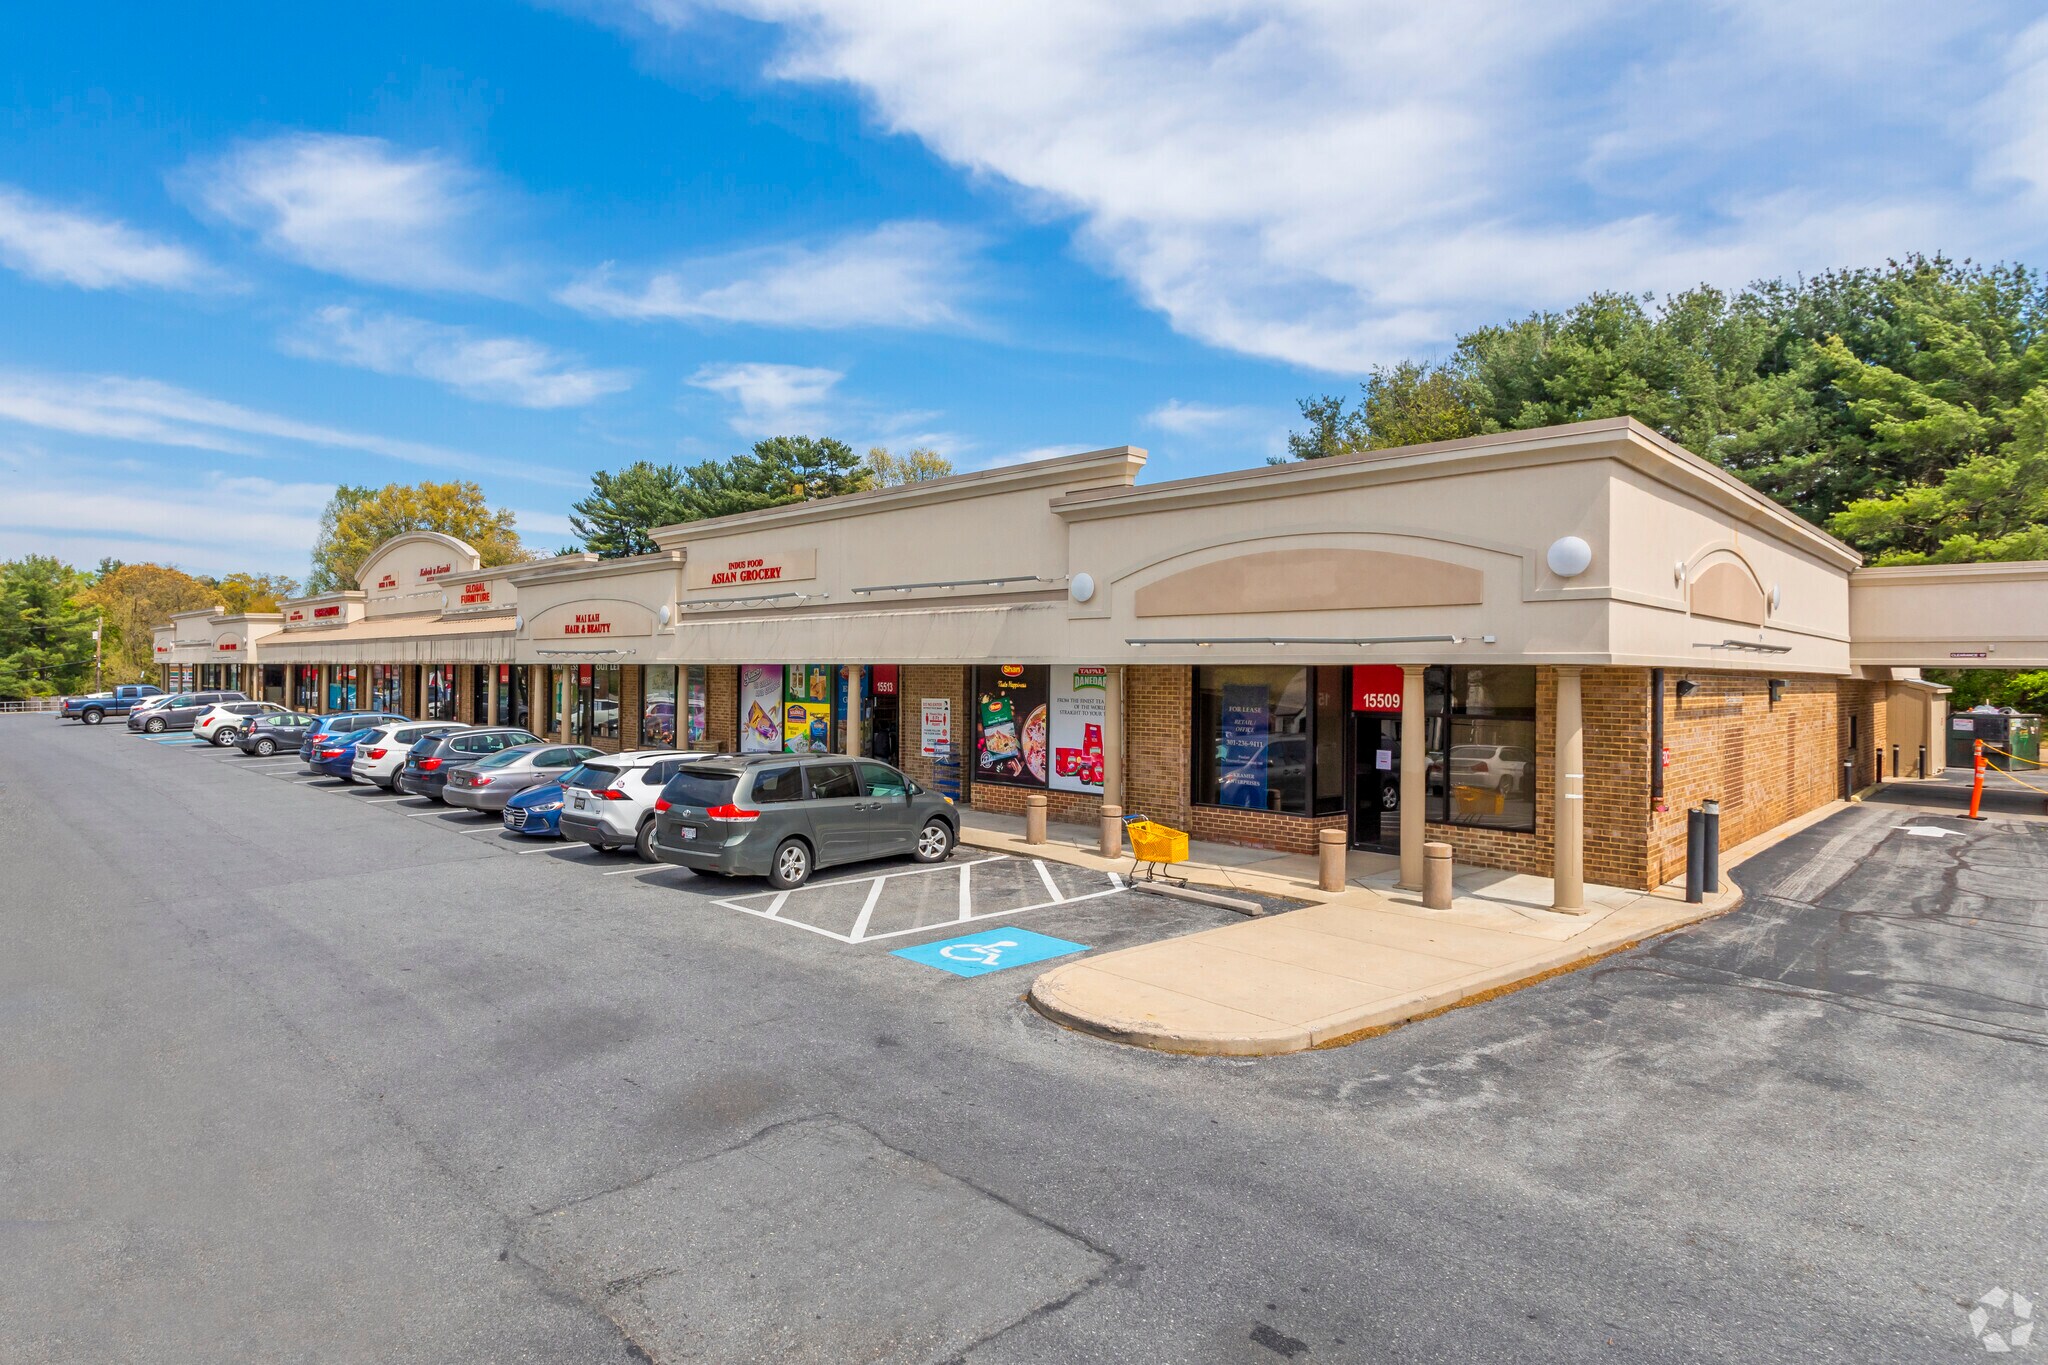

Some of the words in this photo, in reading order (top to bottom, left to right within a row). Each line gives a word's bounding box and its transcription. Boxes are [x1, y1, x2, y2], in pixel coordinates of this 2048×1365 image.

[728, 560, 746, 570] INDUS
[747, 559, 764, 568] FOOD
[711, 572, 737, 584] ASIAN
[740, 567, 782, 582] GROCERY
[466, 582, 485, 593] GLOBAL
[461, 592, 490, 604] FURNITURE
[565, 624, 580, 634] HAIR
[581, 624, 586, 633] &
[587, 623, 611, 633] BEAUTY
[1004, 665, 1021, 673] Shan
[877, 682, 894, 692] 15513
[1363, 693, 1401, 708] 15509
